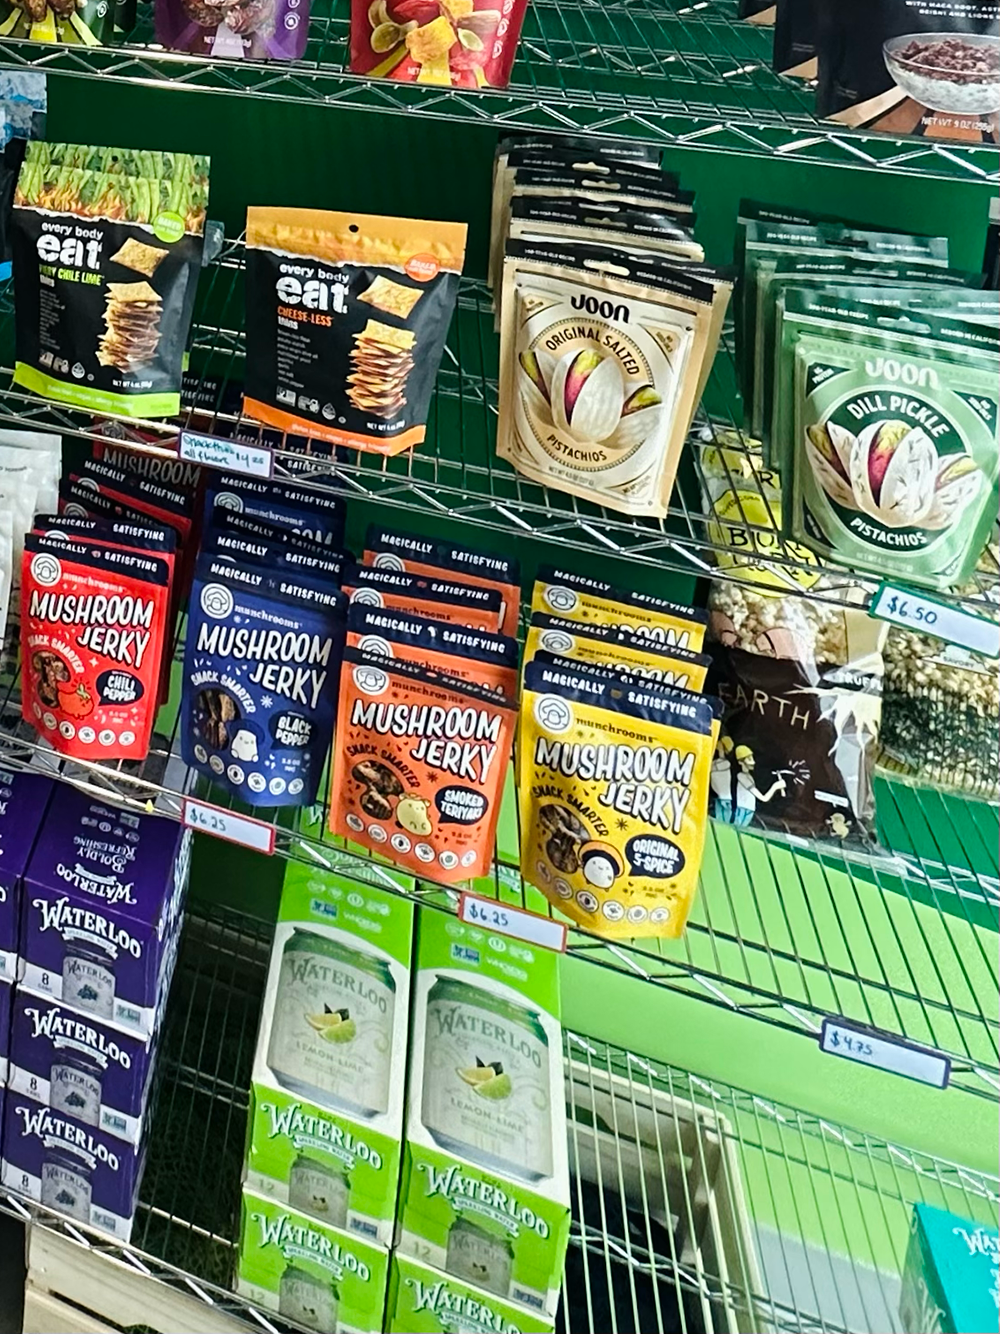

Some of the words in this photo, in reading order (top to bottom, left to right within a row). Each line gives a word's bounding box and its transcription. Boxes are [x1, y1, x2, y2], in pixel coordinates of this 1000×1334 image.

[41, 221, 73, 239] every
[75, 226, 104, 242] body
[36, 233, 103, 270] eat
[279, 263, 315, 279] every
[317, 270, 349, 285] body
[275, 275, 349, 313] eat
[544, 327, 601, 352] ORIGINAL
[601, 332, 641, 378] SALTED
[846, 396, 887, 422] DILL
[889, 396, 951, 440] PICKLE
[546, 433, 608, 463] PISTACHIOS
[848, 516, 929, 547] PISTACHIOS
[38, 537, 87, 555] MAGICALLY
[104, 551, 158, 572] SATISFYING
[210, 563, 262, 586] MAGICALLY
[280, 583, 337, 607] SATISFYING
[30, 589, 155, 629] MUSHROOM
[886, 596, 938, 625] $6.50
[77, 626, 151, 668] JERKY
[197, 623, 333, 667] MUSHROOM
[365, 614, 422, 636] MAGICALLY
[442, 630, 505, 654] SATISFYING
[103, 687, 137, 701] PEPPER
[107, 677, 135, 691] CHILI
[250, 665, 327, 709] JERKY
[542, 670, 605, 695] MAGICALLY
[627, 691, 697, 719] SATISFYING
[278, 715, 312, 731] BLACK
[350, 699, 502, 743] MUSHROOM
[719, 682, 809, 731] EARTH
[275, 725, 309, 747] PEPPER
[411, 739, 497, 784] JERKY
[535, 737, 695, 786] MUSHROOM
[440, 802, 484, 819] TERIYAKI
[444, 789, 484, 805] SMOKED
[599, 781, 690, 835] JERKY
[189, 807, 226, 831] $6.25
[633, 840, 680, 859] ORIGINAL
[633, 853, 674, 874] 5-SPICE
[31, 896, 142, 959] WATERLOO
[468, 902, 509, 926] $6.25
[829, 1030, 873, 1055] $4.75
[15, 1105, 121, 1170] WATERLOO
[261, 1103, 383, 1171] WATERLOO
[417, 1162, 550, 1239] WATERLOO
[251, 1213, 371, 1281] WATERLOO
